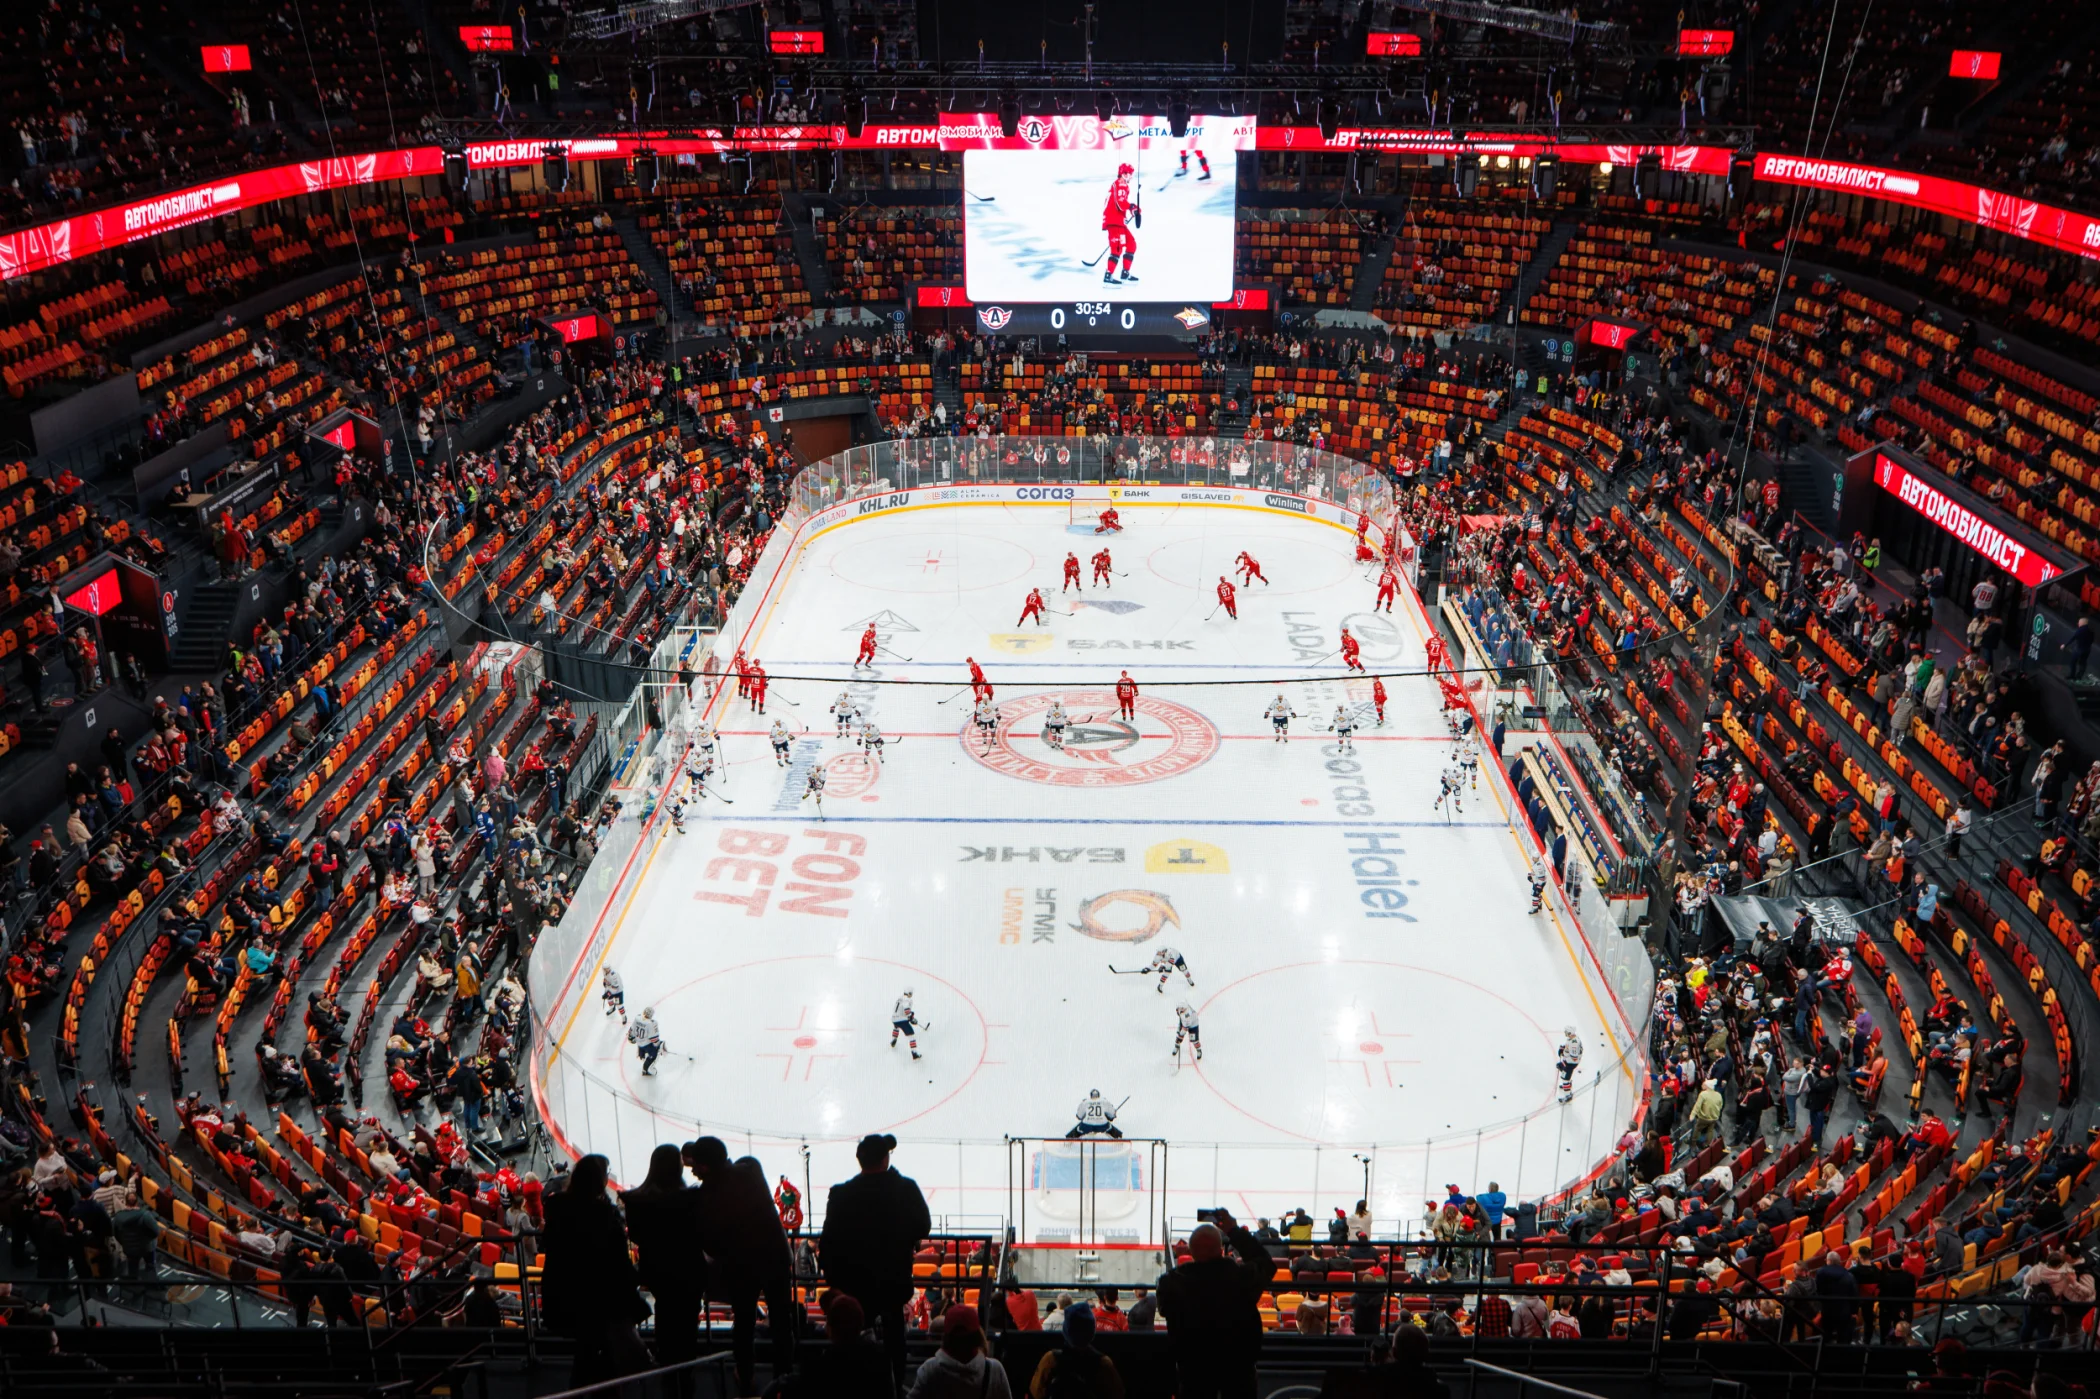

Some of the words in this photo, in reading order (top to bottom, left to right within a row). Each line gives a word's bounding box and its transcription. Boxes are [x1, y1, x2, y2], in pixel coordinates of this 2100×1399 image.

[1054, 116, 1100, 148] VS
[1764, 158, 1885, 190] АВТОМОБИЛИСТ
[124, 187, 213, 230] АВТОМОБИЛИСТ
[1050, 308, 1065, 329] 0
[1075, 302, 1111, 316] 30:54
[1121, 308, 1135, 329] 0
[1089, 316, 1096, 327] 0
[692, 480, 701, 489] 24
[1124, 490, 1150, 498] БАНК
[1767, 490, 1778, 500] 22
[858, 493, 910, 514] KHL.RU
[1181, 493, 1231, 501] GISLAVED
[1267, 494, 1304, 511] Winline
[1899, 473, 2026, 574] АВТОМОБИЛИСТ
[1066, 639, 1197, 650] БАНК
[1281, 611, 1329, 661] LADA
[1430, 643, 1441, 654] 77
[957, 845, 1127, 863] БАНК
[693, 827, 791, 918] BET
[778, 828, 868, 919] FON
[1343, 831, 1420, 924] Haier
[999, 887, 1025, 946] UMMC
[1032, 887, 1057, 945] УГМК
[633, 1025, 645, 1040] 30
[1086, 1105, 1103, 1117] 20
